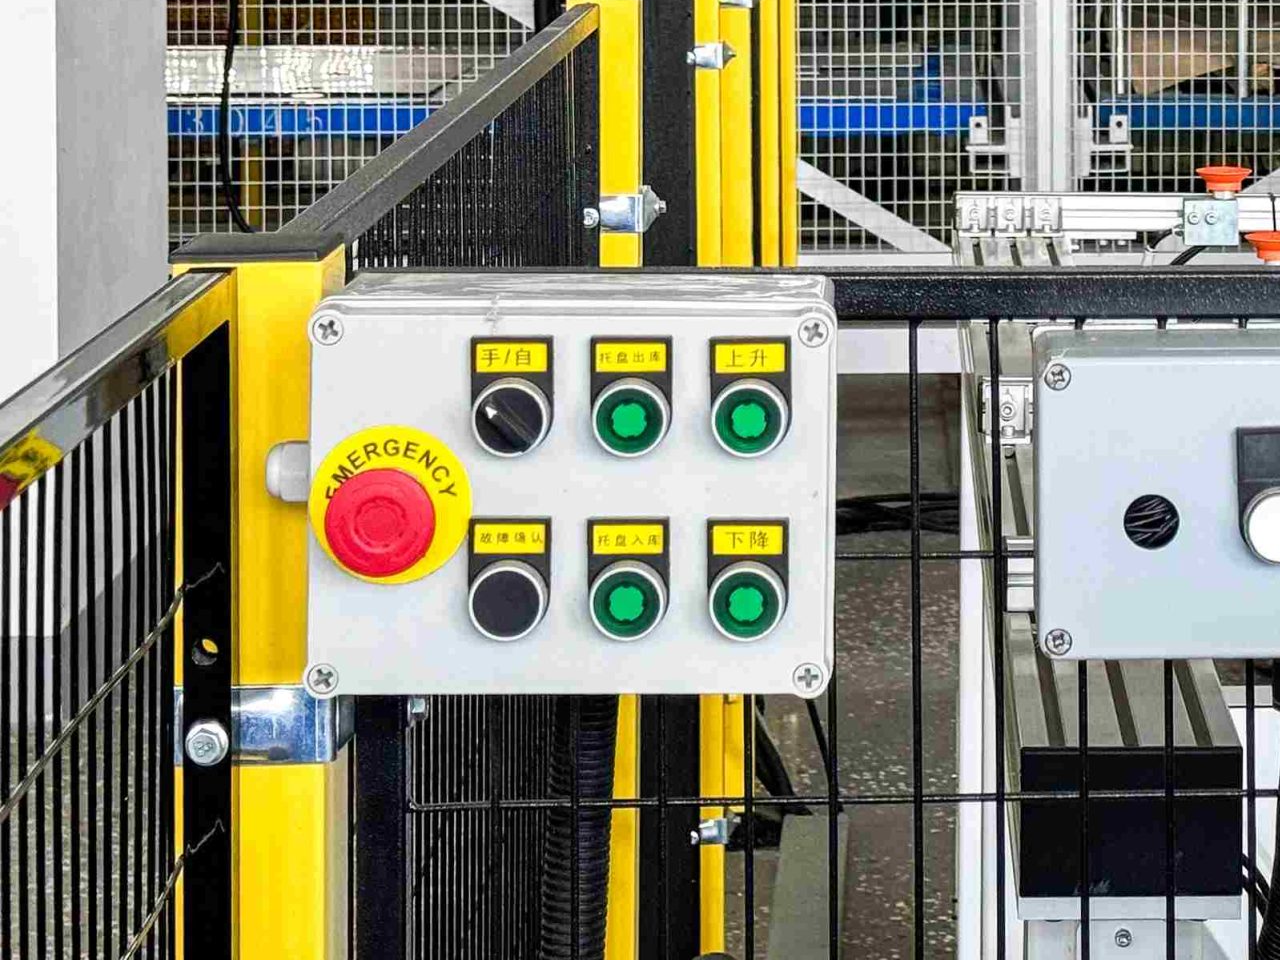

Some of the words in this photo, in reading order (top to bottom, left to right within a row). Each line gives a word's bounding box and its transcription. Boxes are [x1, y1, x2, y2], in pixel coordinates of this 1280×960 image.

[481, 348, 531, 367] 手/自
[725, 348, 768, 368] 上升
[325, 439, 457, 500] EMERGENCY
[597, 533, 660, 547] 托盘入库
[725, 530, 768, 550] 下降
